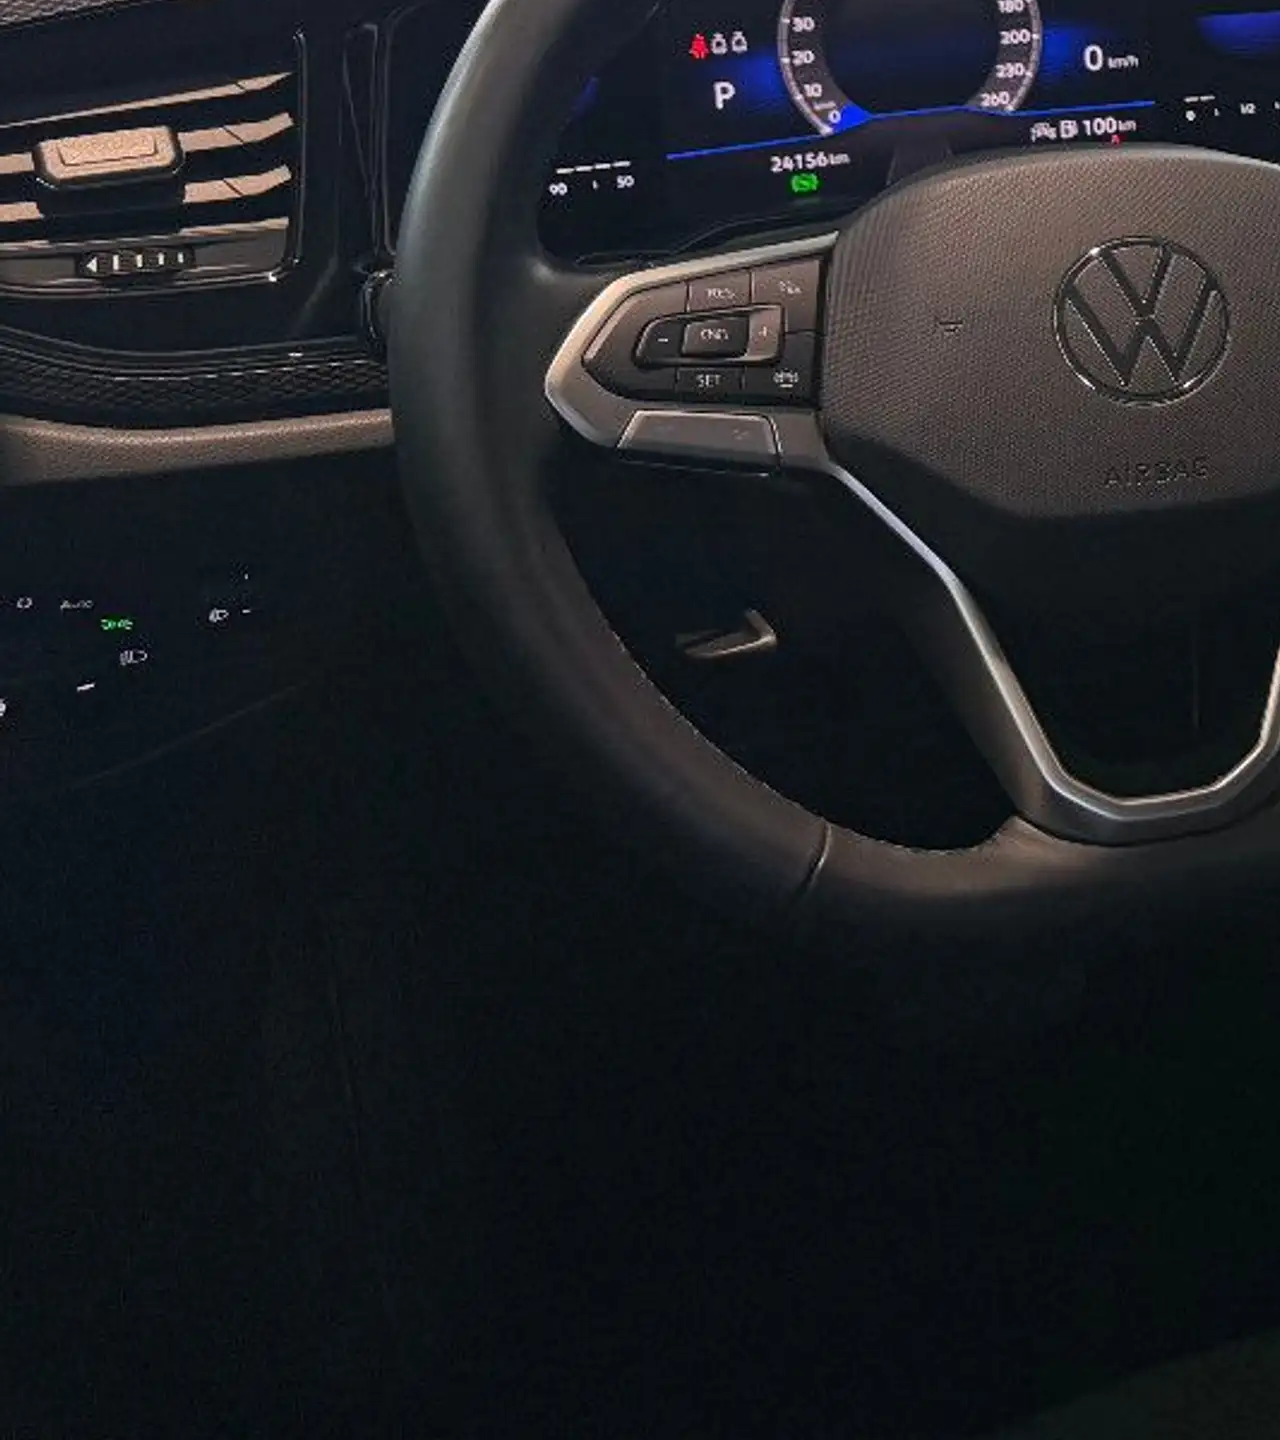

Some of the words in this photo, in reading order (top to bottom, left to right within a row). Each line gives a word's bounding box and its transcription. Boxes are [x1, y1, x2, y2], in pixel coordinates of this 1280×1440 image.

[791, 16, 816, 32] 30
[999, 28, 1031, 46] 200
[791, 50, 816, 66] 20
[1083, 45, 1104, 71] 0
[1107, 54, 1139, 70] km/h
[995, 63, 1025, 79] 230
[713, 80, 736, 111] P
[803, 83, 823, 98] 10
[980, 91, 1010, 108] 260
[827, 110, 842, 124] 0
[1082, 117, 1117, 135] 100
[771, 152, 829, 174] 24156
[616, 174, 635, 189] 50
[1103, 461, 1209, 488] AIRBAG
